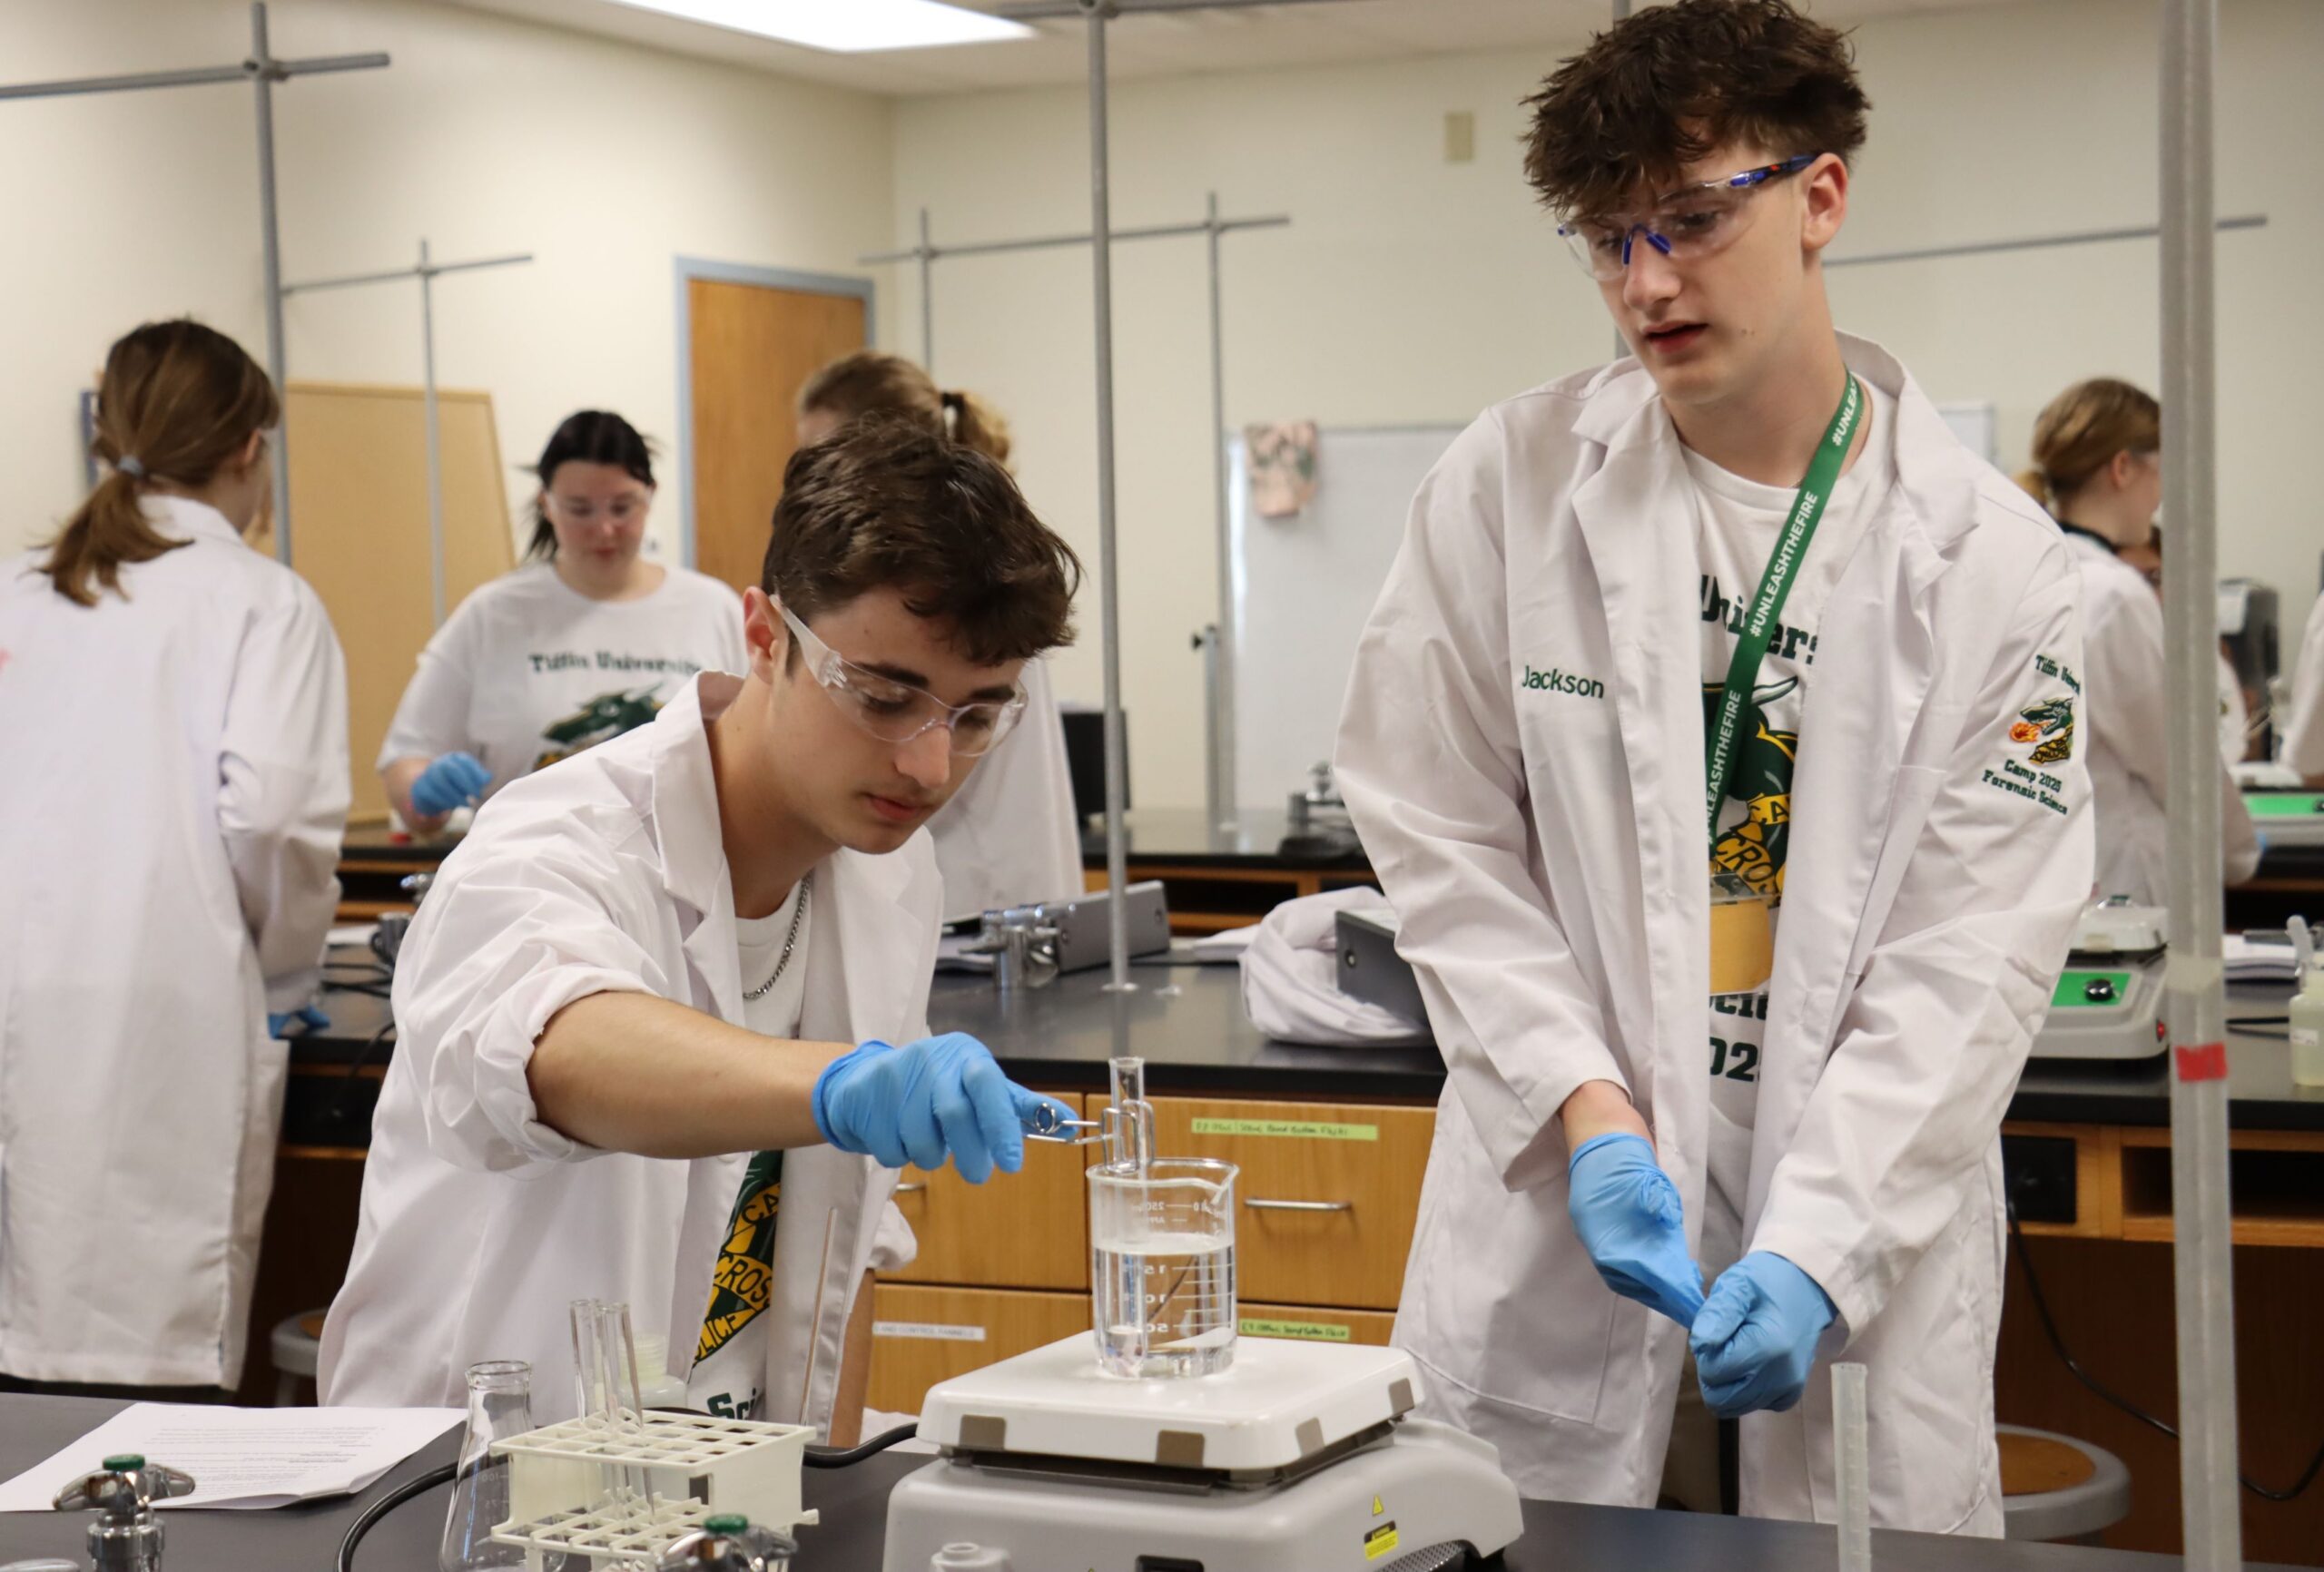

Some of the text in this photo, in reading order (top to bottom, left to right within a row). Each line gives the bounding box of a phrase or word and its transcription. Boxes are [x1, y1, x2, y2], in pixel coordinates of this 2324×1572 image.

[1749, 490, 1818, 637] #UNLEASHTHEFIRE
[1521, 664, 1604, 699] Jackson
[1982, 769, 2036, 800] Forensic
[2004, 759, 2062, 793] Camp 2025
[1716, 831, 1773, 892] CRO
[714, 1253, 772, 1307] CROS
